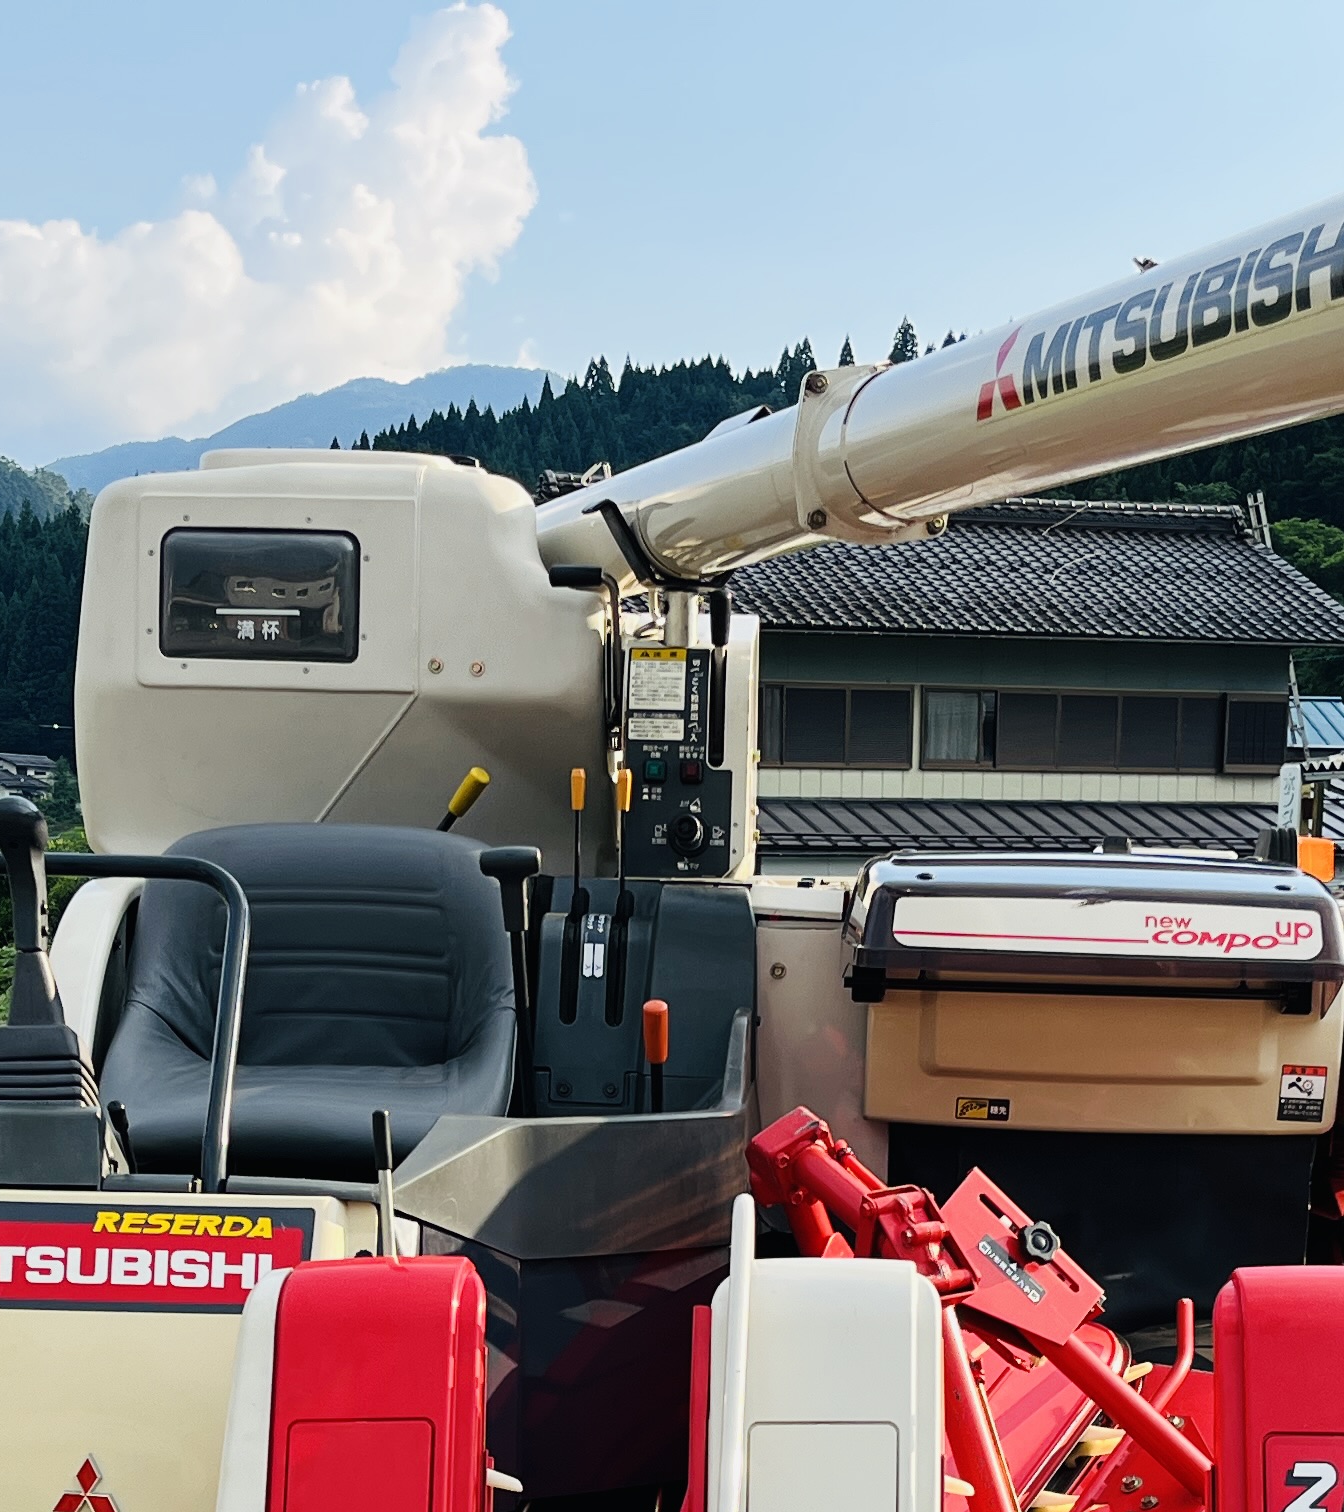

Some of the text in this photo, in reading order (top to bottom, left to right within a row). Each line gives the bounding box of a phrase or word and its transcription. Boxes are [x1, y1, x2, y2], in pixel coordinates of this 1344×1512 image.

[236, 619, 281, 641] 満杯
[1144, 915, 1193, 929] new
[92, 1211, 274, 1239] RESERDA
